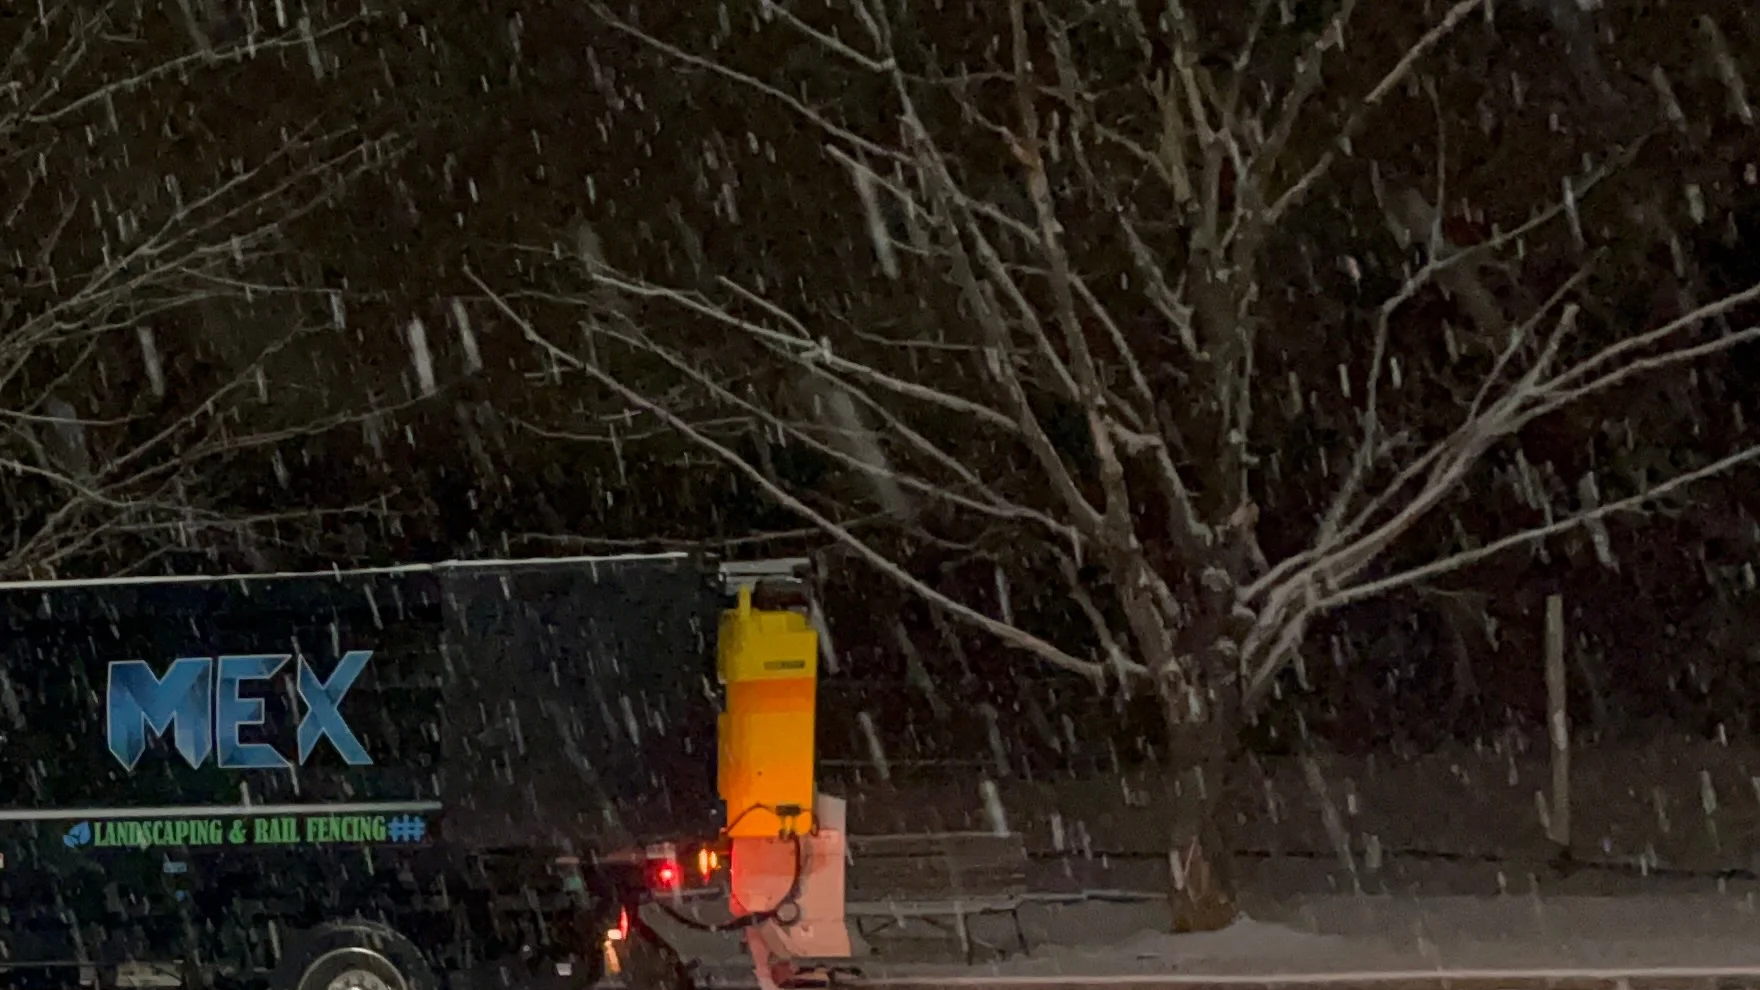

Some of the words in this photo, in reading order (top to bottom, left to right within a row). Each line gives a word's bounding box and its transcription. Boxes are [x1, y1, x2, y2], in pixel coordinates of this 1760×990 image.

[106, 650, 374, 773] MEX
[93, 819, 223, 847] LANDSCAPING
[229, 818, 247, 844] &
[254, 817, 301, 844] RAIL
[306, 815, 386, 843] FENCING
